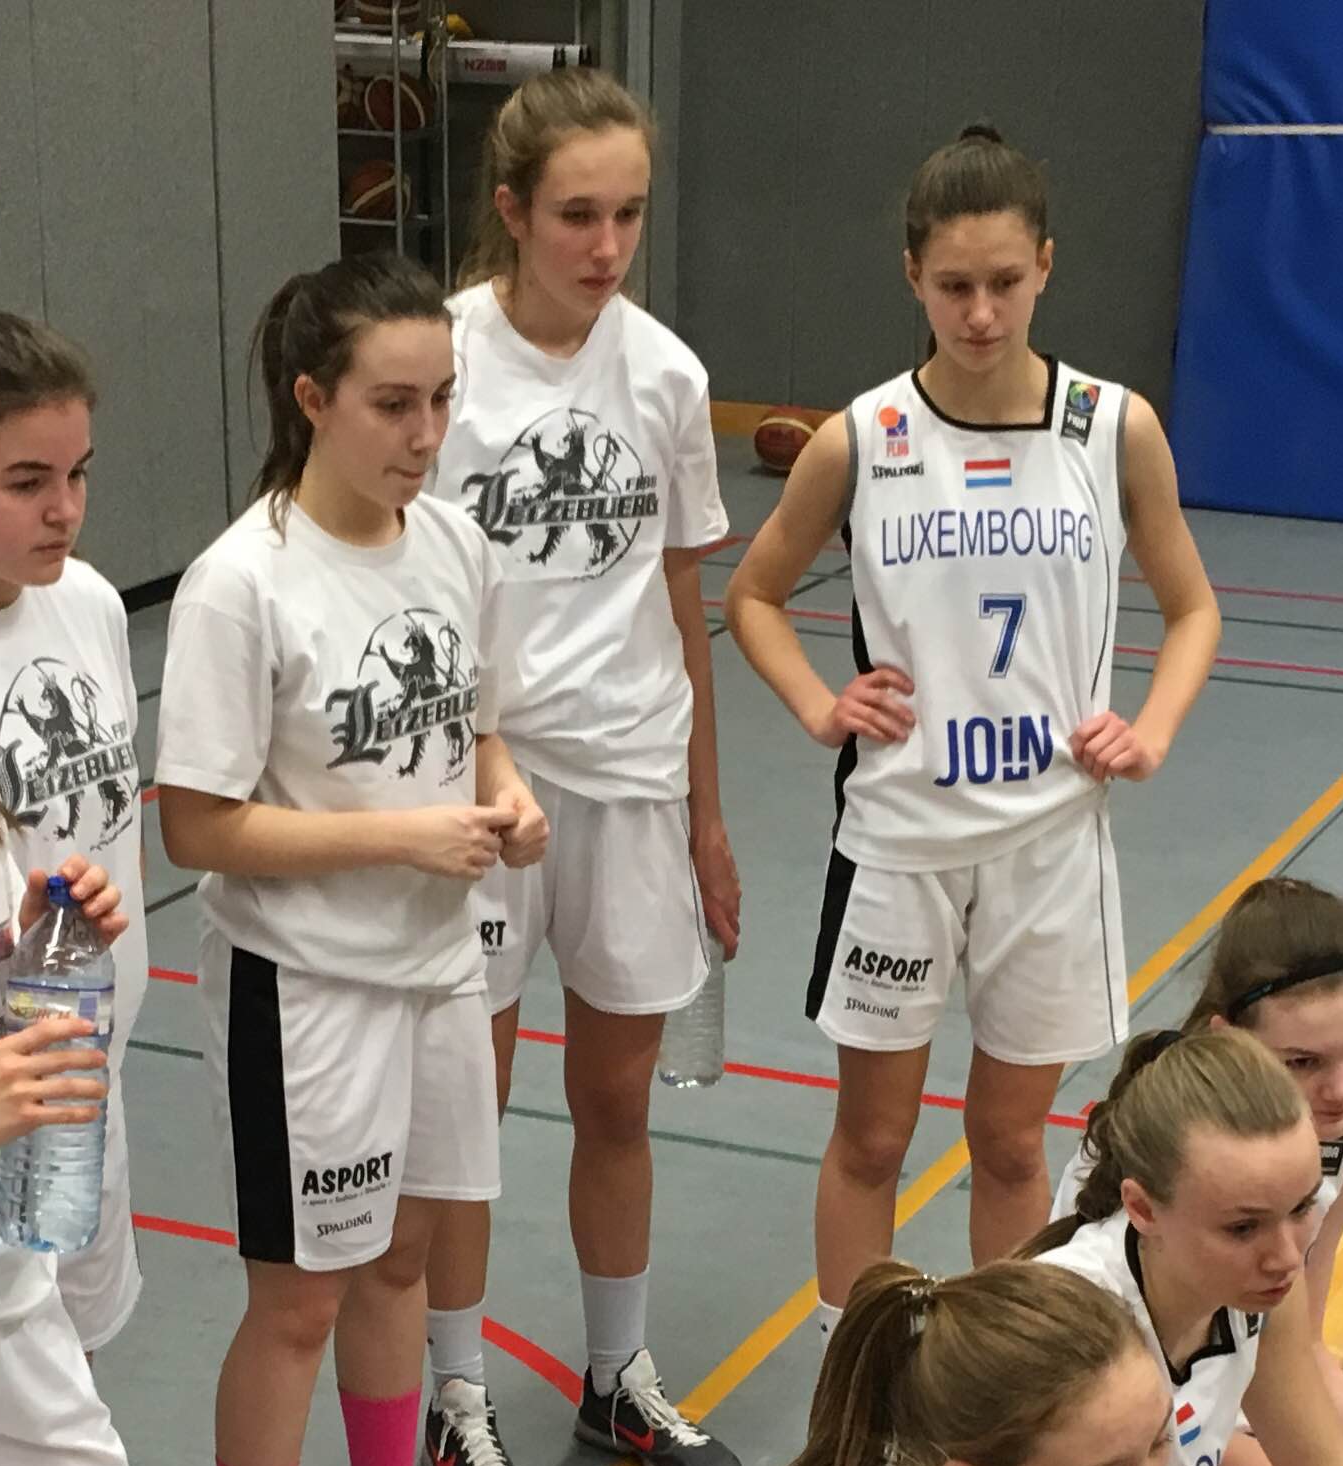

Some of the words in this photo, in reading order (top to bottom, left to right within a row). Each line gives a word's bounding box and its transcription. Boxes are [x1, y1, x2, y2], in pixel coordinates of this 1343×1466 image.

[880, 506, 1094, 567] LUXEMBOURG
[978, 593, 1028, 680] 7
[844, 944, 934, 983] ASPORT
[844, 996, 901, 1021] SPALDING
[301, 1151, 394, 1197] ASPORT
[316, 1209, 374, 1239] SPALDING
